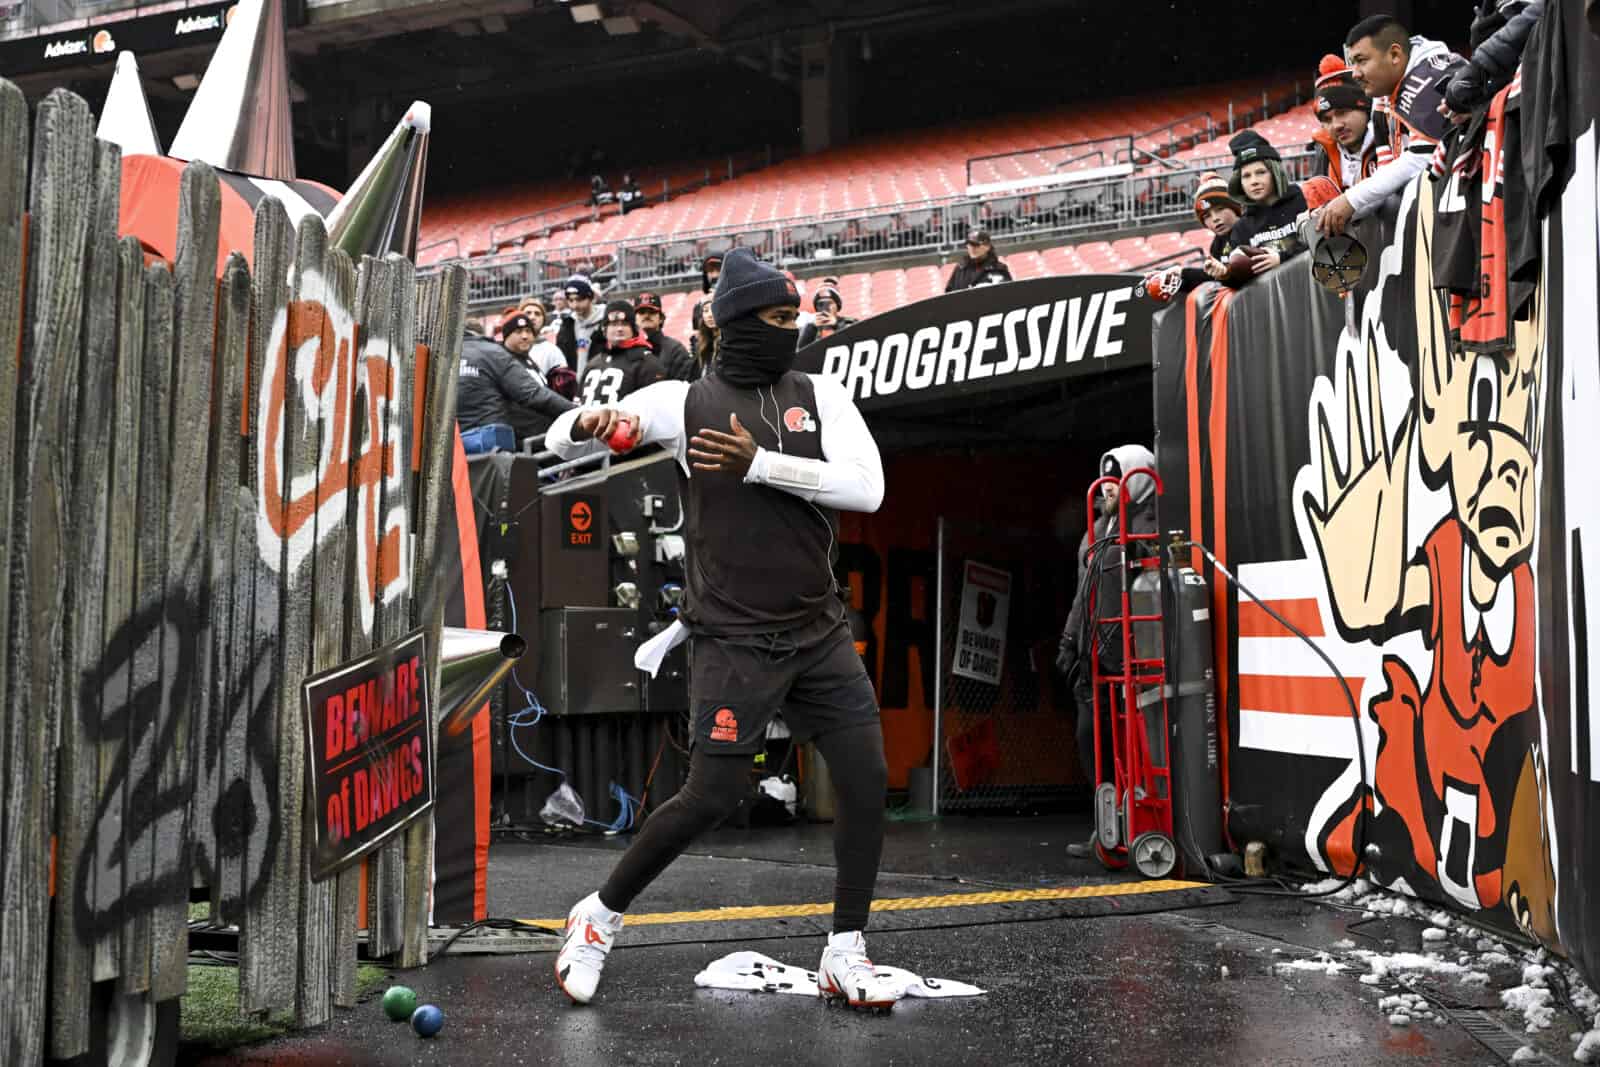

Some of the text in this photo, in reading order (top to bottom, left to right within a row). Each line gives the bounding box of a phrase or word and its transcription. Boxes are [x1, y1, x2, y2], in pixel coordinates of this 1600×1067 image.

[1399, 75, 1433, 115] HALL
[821, 286, 1134, 399] PROGRESSIVE
[581, 367, 625, 405] 33
[569, 532, 593, 545] EXIT
[325, 655, 421, 761] BEWARE
[353, 735, 424, 833] DAWGS
